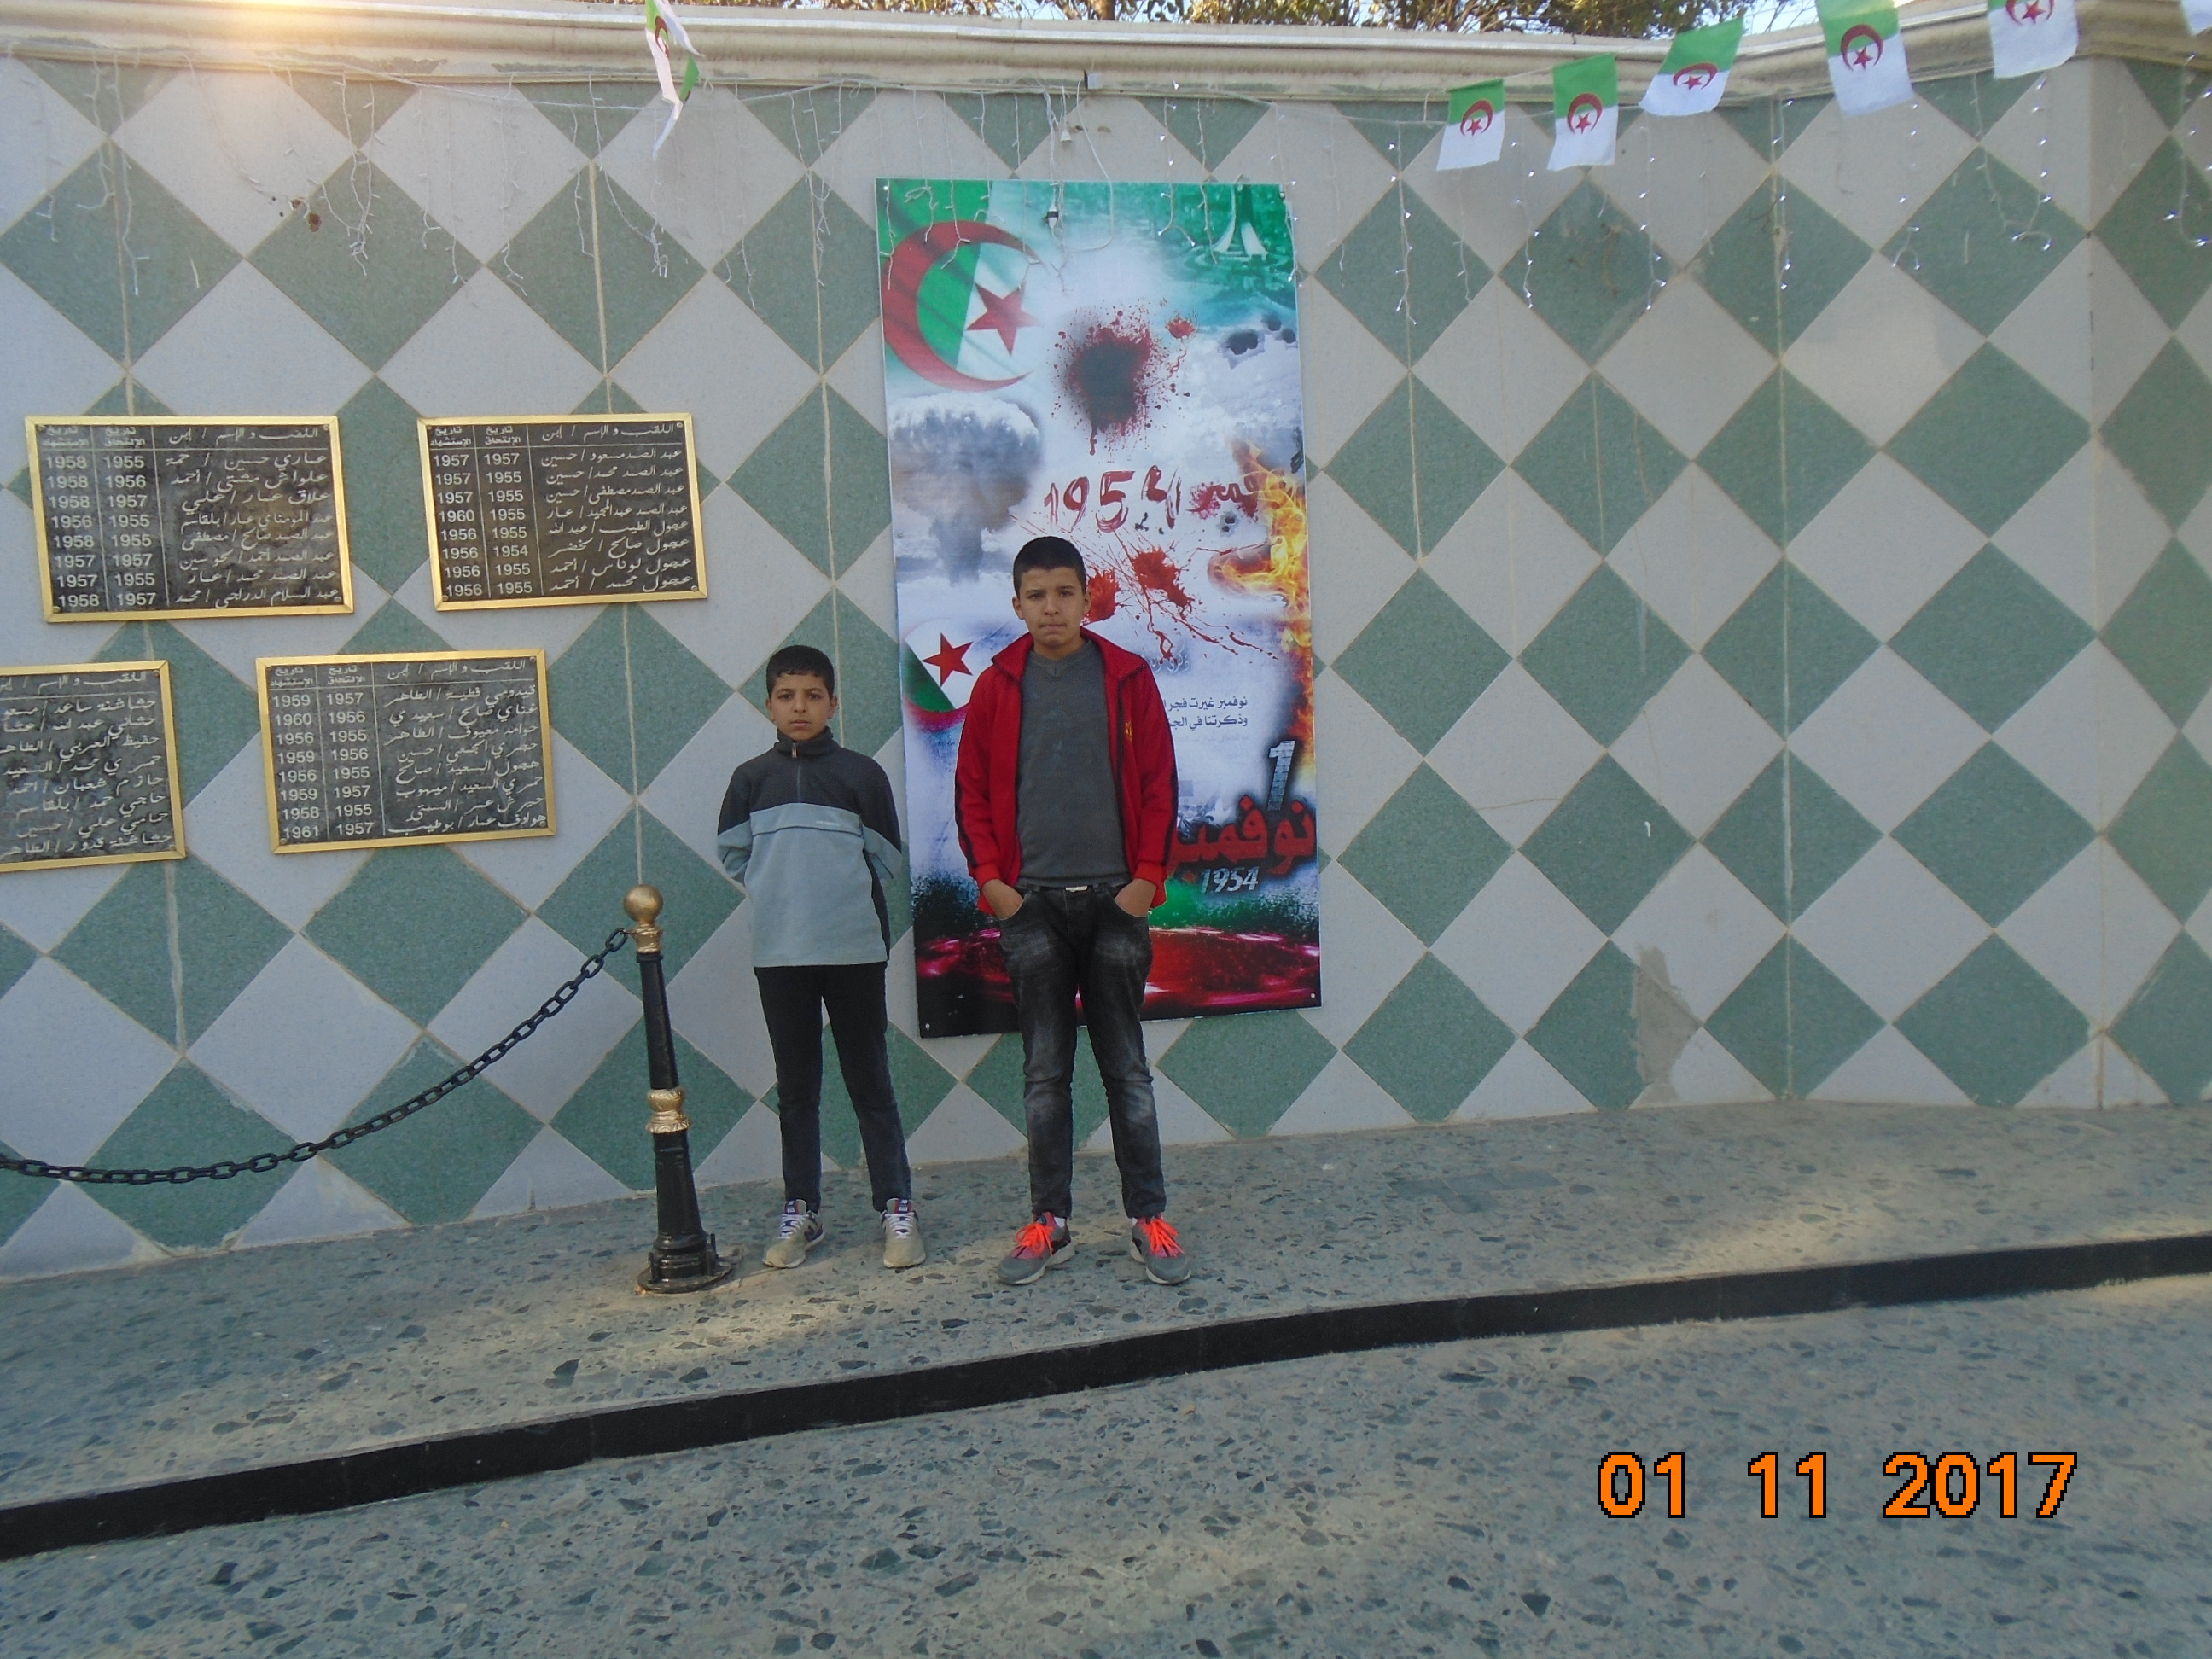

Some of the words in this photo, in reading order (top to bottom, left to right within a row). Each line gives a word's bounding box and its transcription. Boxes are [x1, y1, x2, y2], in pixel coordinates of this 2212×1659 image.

[621, 424, 674, 437] اللقب
[434, 454, 469, 467] 1957
[483, 452, 520, 465] 1957
[541, 452, 578, 468] حسين
[590, 453, 625, 463] مسعود
[660, 449, 682, 460] عبد
[46, 456, 87, 469] 1958
[103, 456, 145, 469] 1955
[224, 456, 270, 471] حسين
[486, 471, 522, 483] 1955
[546, 470, 585, 486] حسين
[594, 466, 618, 478] محمد
[660, 466, 683, 477] عبد
[48, 475, 89, 489] 1958
[106, 475, 146, 488] 1956
[435, 473, 471, 486] 1957
[487, 489, 524, 502] 1955
[545, 488, 580, 504] حسين
[665, 485, 685, 495] عبد
[49, 495, 90, 509] 1958
[107, 494, 148, 508] 1957
[182, 490, 225, 512] علي
[437, 491, 474, 504] 1957
[1044, 465, 1182, 533] 1954
[439, 509, 474, 522] 1960
[490, 508, 526, 521] 1955
[667, 504, 688, 515] عبد
[51, 515, 92, 528] 1956
[109, 515, 150, 527] 1955
[181, 512, 221, 533] بلقاسم
[599, 520, 650, 533] الطيب
[311, 531, 334, 540] عبد
[440, 528, 477, 541] 1956
[492, 527, 527, 539] 1955
[568, 524, 588, 534] عبد
[654, 521, 689, 537] عجول
[53, 535, 95, 548] 1958
[111, 533, 152, 546] 1955
[241, 527, 272, 550] صالح
[493, 545, 528, 557] 1954
[608, 536, 643, 558] صالح
[646, 538, 690, 555] عجول
[112, 553, 153, 567] 1957
[312, 551, 335, 562] عبد
[442, 547, 479, 560] 1956
[55, 555, 96, 568] 1957
[550, 557, 578, 573] أحمد
[646, 557, 691, 575] عجول
[236, 569, 264, 581] محمد
[311, 570, 336, 580] عبد
[445, 565, 480, 578] 1956
[495, 563, 531, 576] 1955
[56, 574, 97, 587] 1957
[114, 573, 155, 586] 1955
[549, 575, 579, 591] أحمد
[606, 575, 637, 588] محمد
[643, 575, 693, 593] عجول
[316, 589, 339, 598] عبد
[446, 583, 482, 597] 1956
[497, 581, 533, 594] 1955
[59, 594, 100, 607] 1958
[116, 593, 156, 606] 1957
[175, 590, 201, 602] محمد
[271, 586, 310, 606] السلام
[470, 660, 526, 674] اللقب
[84, 671, 146, 688] اللقب
[273, 694, 310, 707] 1959
[326, 692, 364, 705] 1957
[383, 689, 432, 707] الطاهر
[1190, 697, 1214, 710] غيرت
[1217, 696, 1248, 709] نوفمبر
[1168, 698, 1187, 712] فجر
[275, 713, 311, 726] 1960
[329, 711, 365, 724] 1956
[458, 703, 494, 726] صالح
[1204, 714, 1248, 728] وذكرتنا
[78, 719, 105, 731] عبد
[1190, 716, 1202, 731] في
[276, 731, 314, 745] 1956
[329, 730, 367, 742] 1955
[383, 727, 434, 746] الطاهر
[60, 736, 110, 761] العربي
[331, 748, 368, 760] 1956
[397, 748, 434, 762] حسين
[277, 750, 315, 764] 1959
[333, 766, 370, 779] 1955
[396, 760, 432, 784] صالح
[447, 760, 491, 775] السعيد
[279, 770, 317, 783] 1956
[1269, 740, 1295, 811] 1
[335, 785, 370, 798] 1957
[460, 778, 498, 793] السعيد
[281, 788, 317, 800] 1959
[282, 806, 319, 820] 1958
[335, 804, 372, 817] 1955
[283, 825, 319, 839] 1961
[336, 822, 374, 835] 1957
[1201, 866, 1259, 894] 1954
